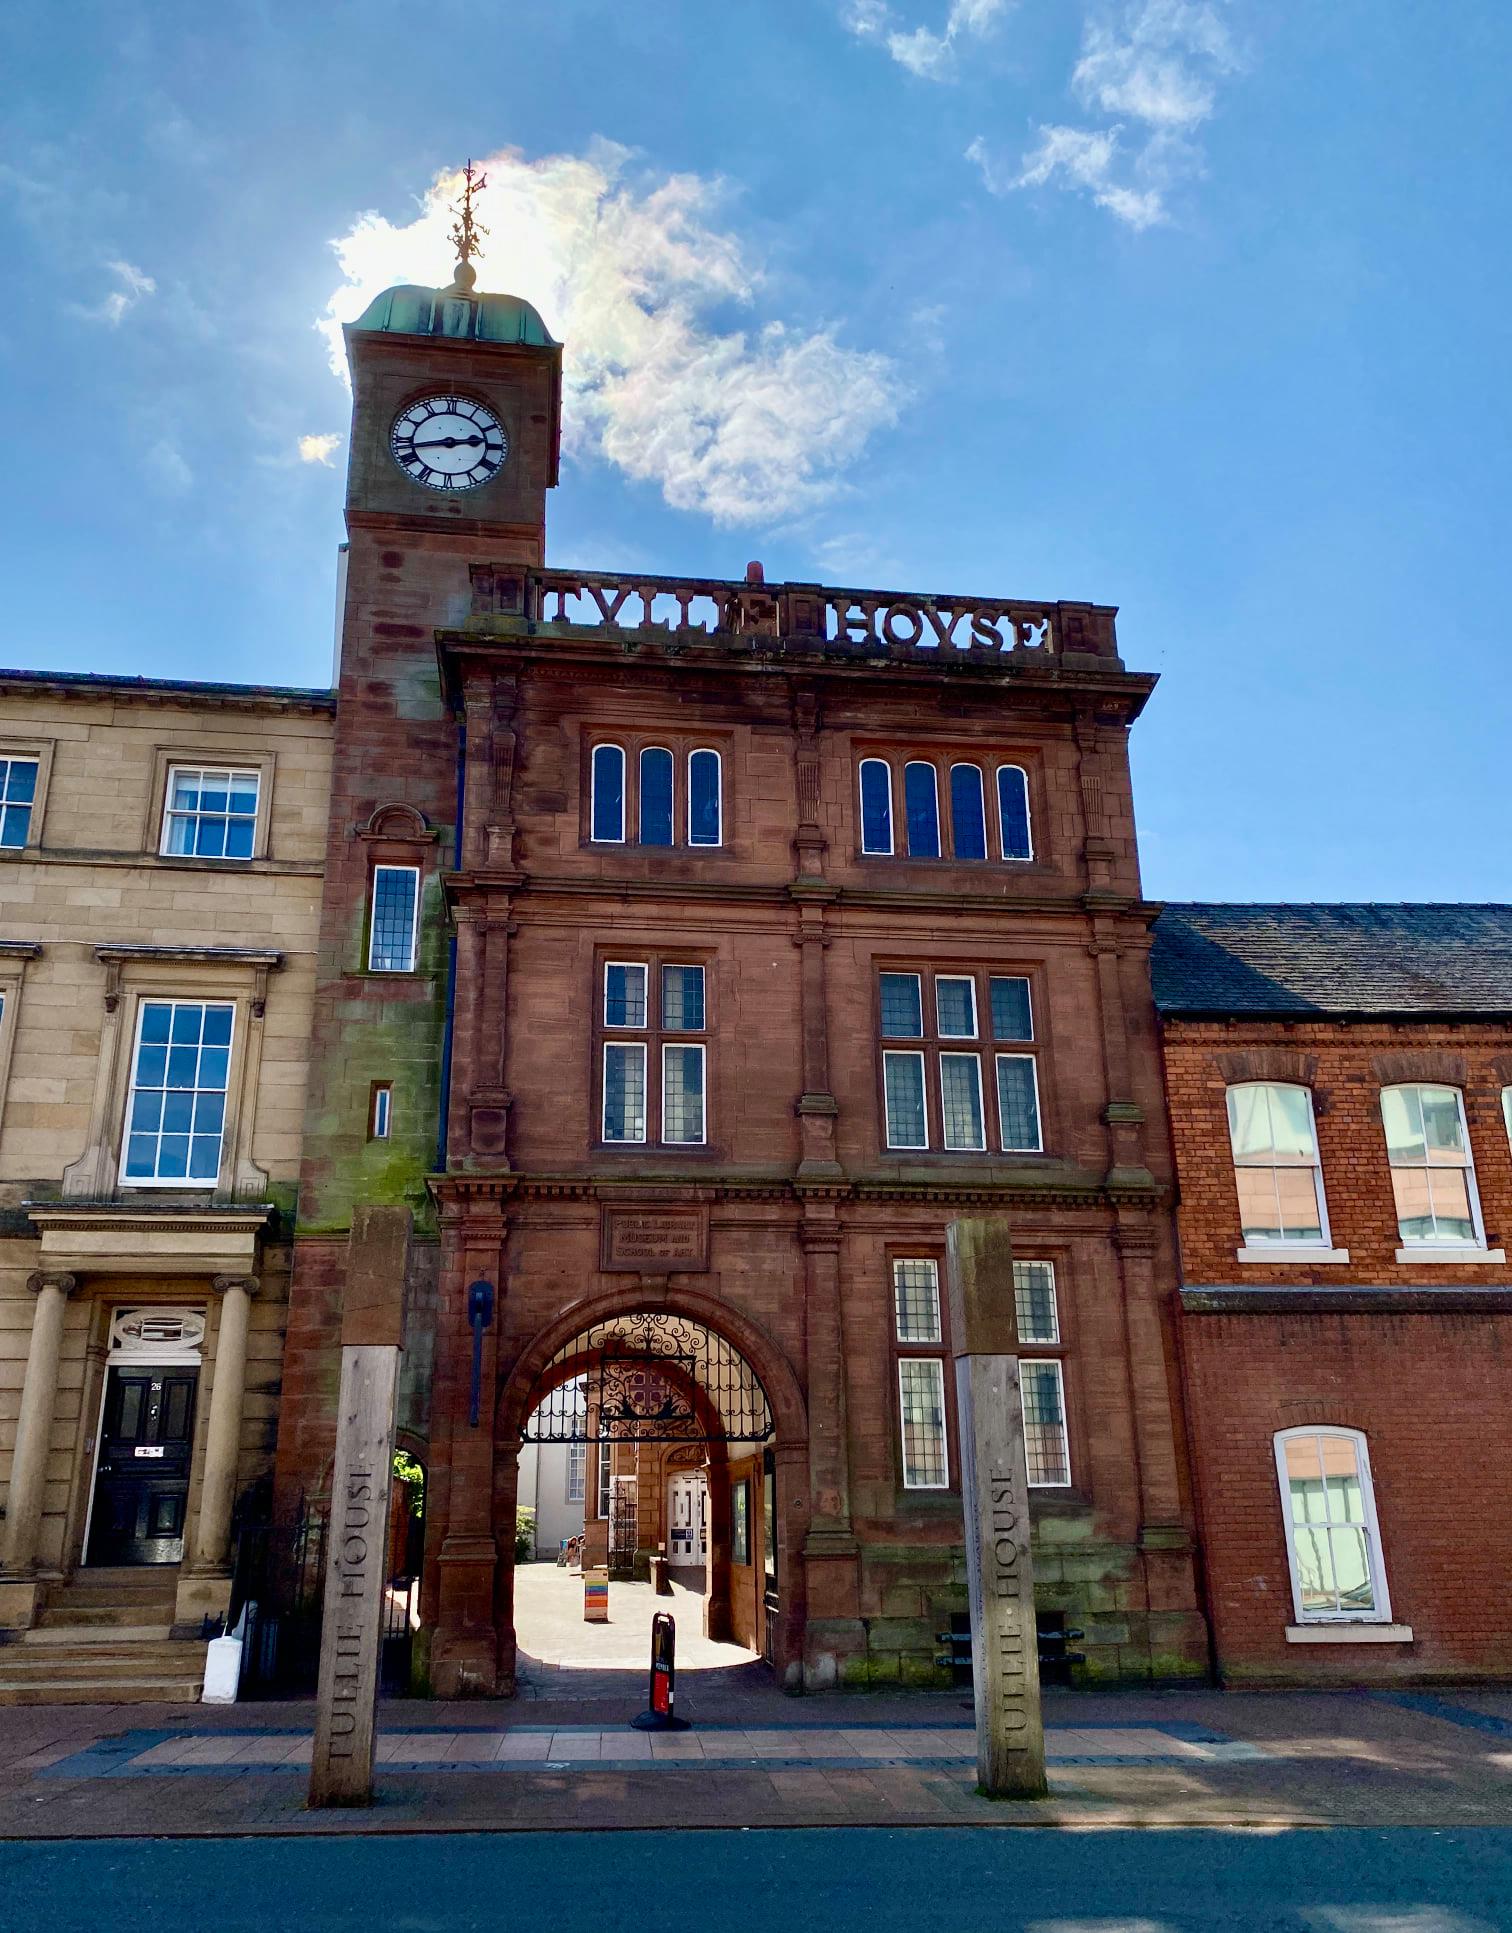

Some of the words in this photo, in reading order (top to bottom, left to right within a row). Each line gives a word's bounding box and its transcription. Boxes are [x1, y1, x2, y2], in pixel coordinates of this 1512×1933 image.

[151, 1382, 161, 1390] 26
[341, 1463, 375, 1598] HOUSE
[991, 1468, 1020, 1599] HOUSE
[327, 1625, 366, 1771] TULLIE
[998, 1624, 1029, 1768] TULLIE
